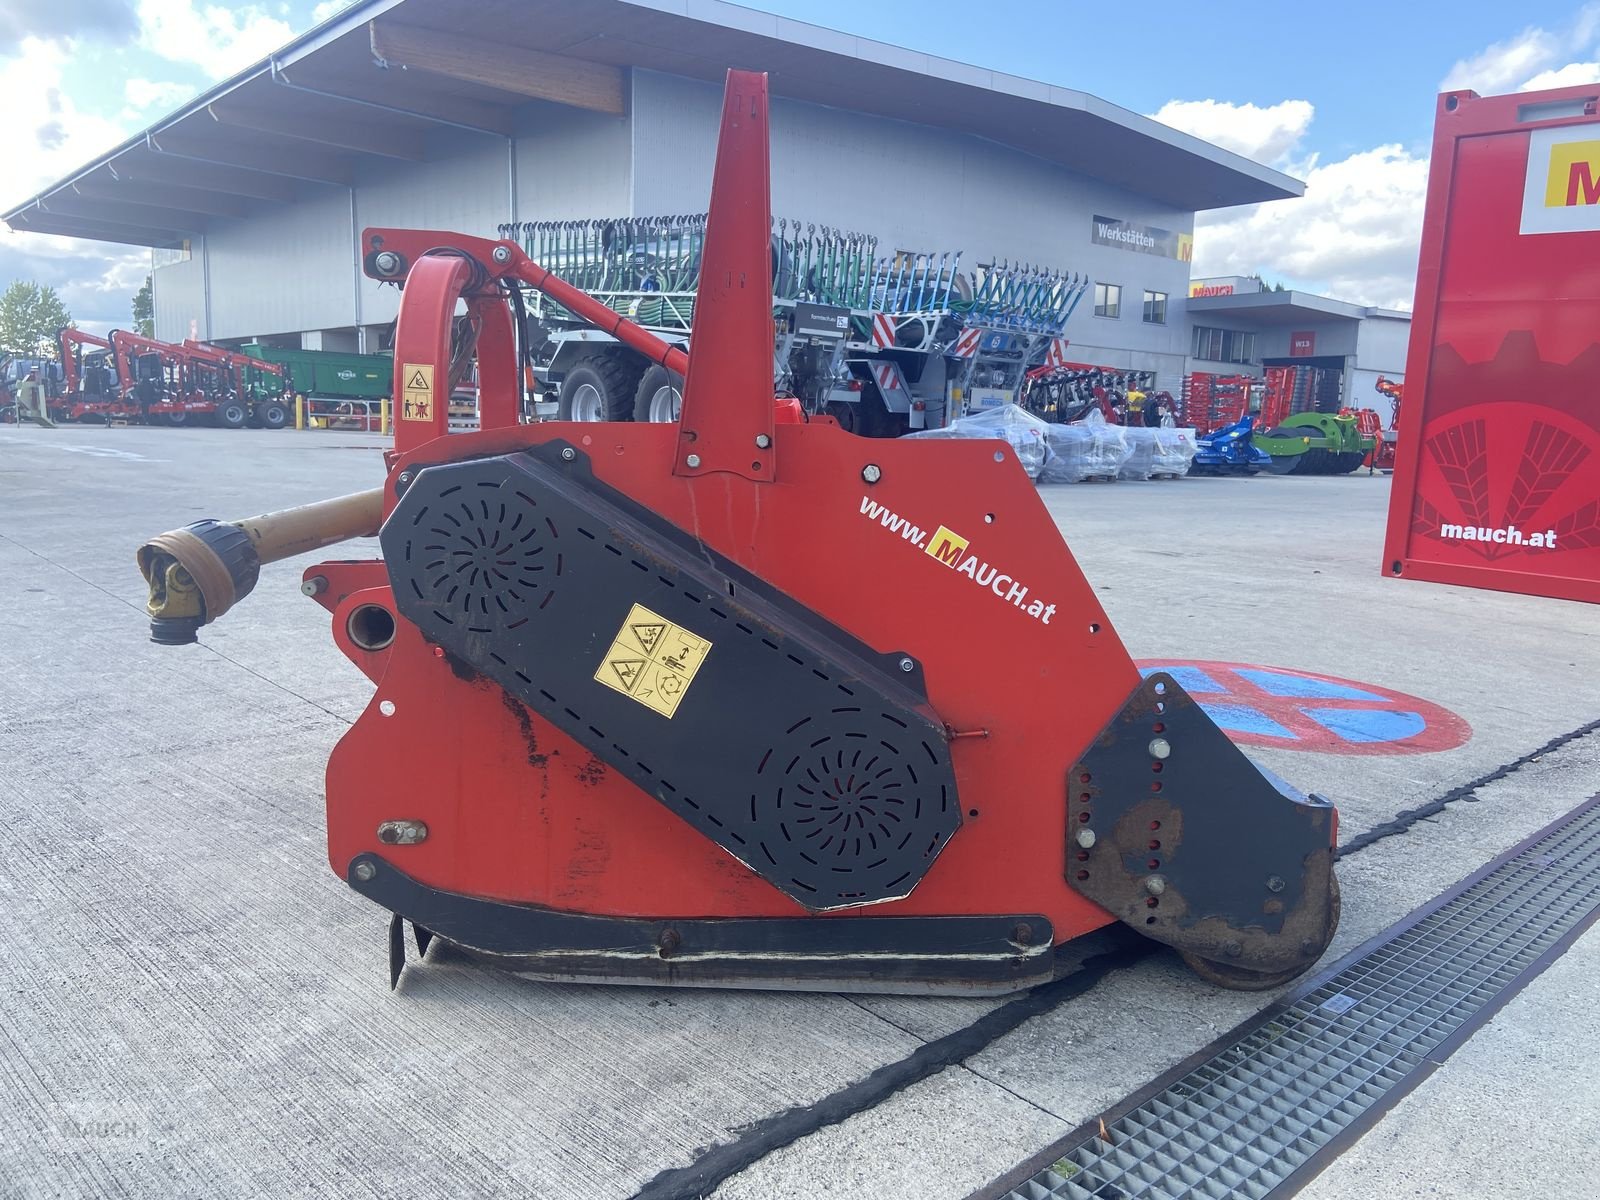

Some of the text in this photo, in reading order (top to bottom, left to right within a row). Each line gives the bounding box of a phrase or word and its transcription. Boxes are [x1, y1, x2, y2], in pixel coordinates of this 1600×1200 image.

[1098, 223, 1155, 248] Werkstätten
[1193, 285, 1233, 298] MAUCH
[1440, 523, 1558, 549] mauch.at
[859, 495, 1057, 625] www.MAUCH.at
